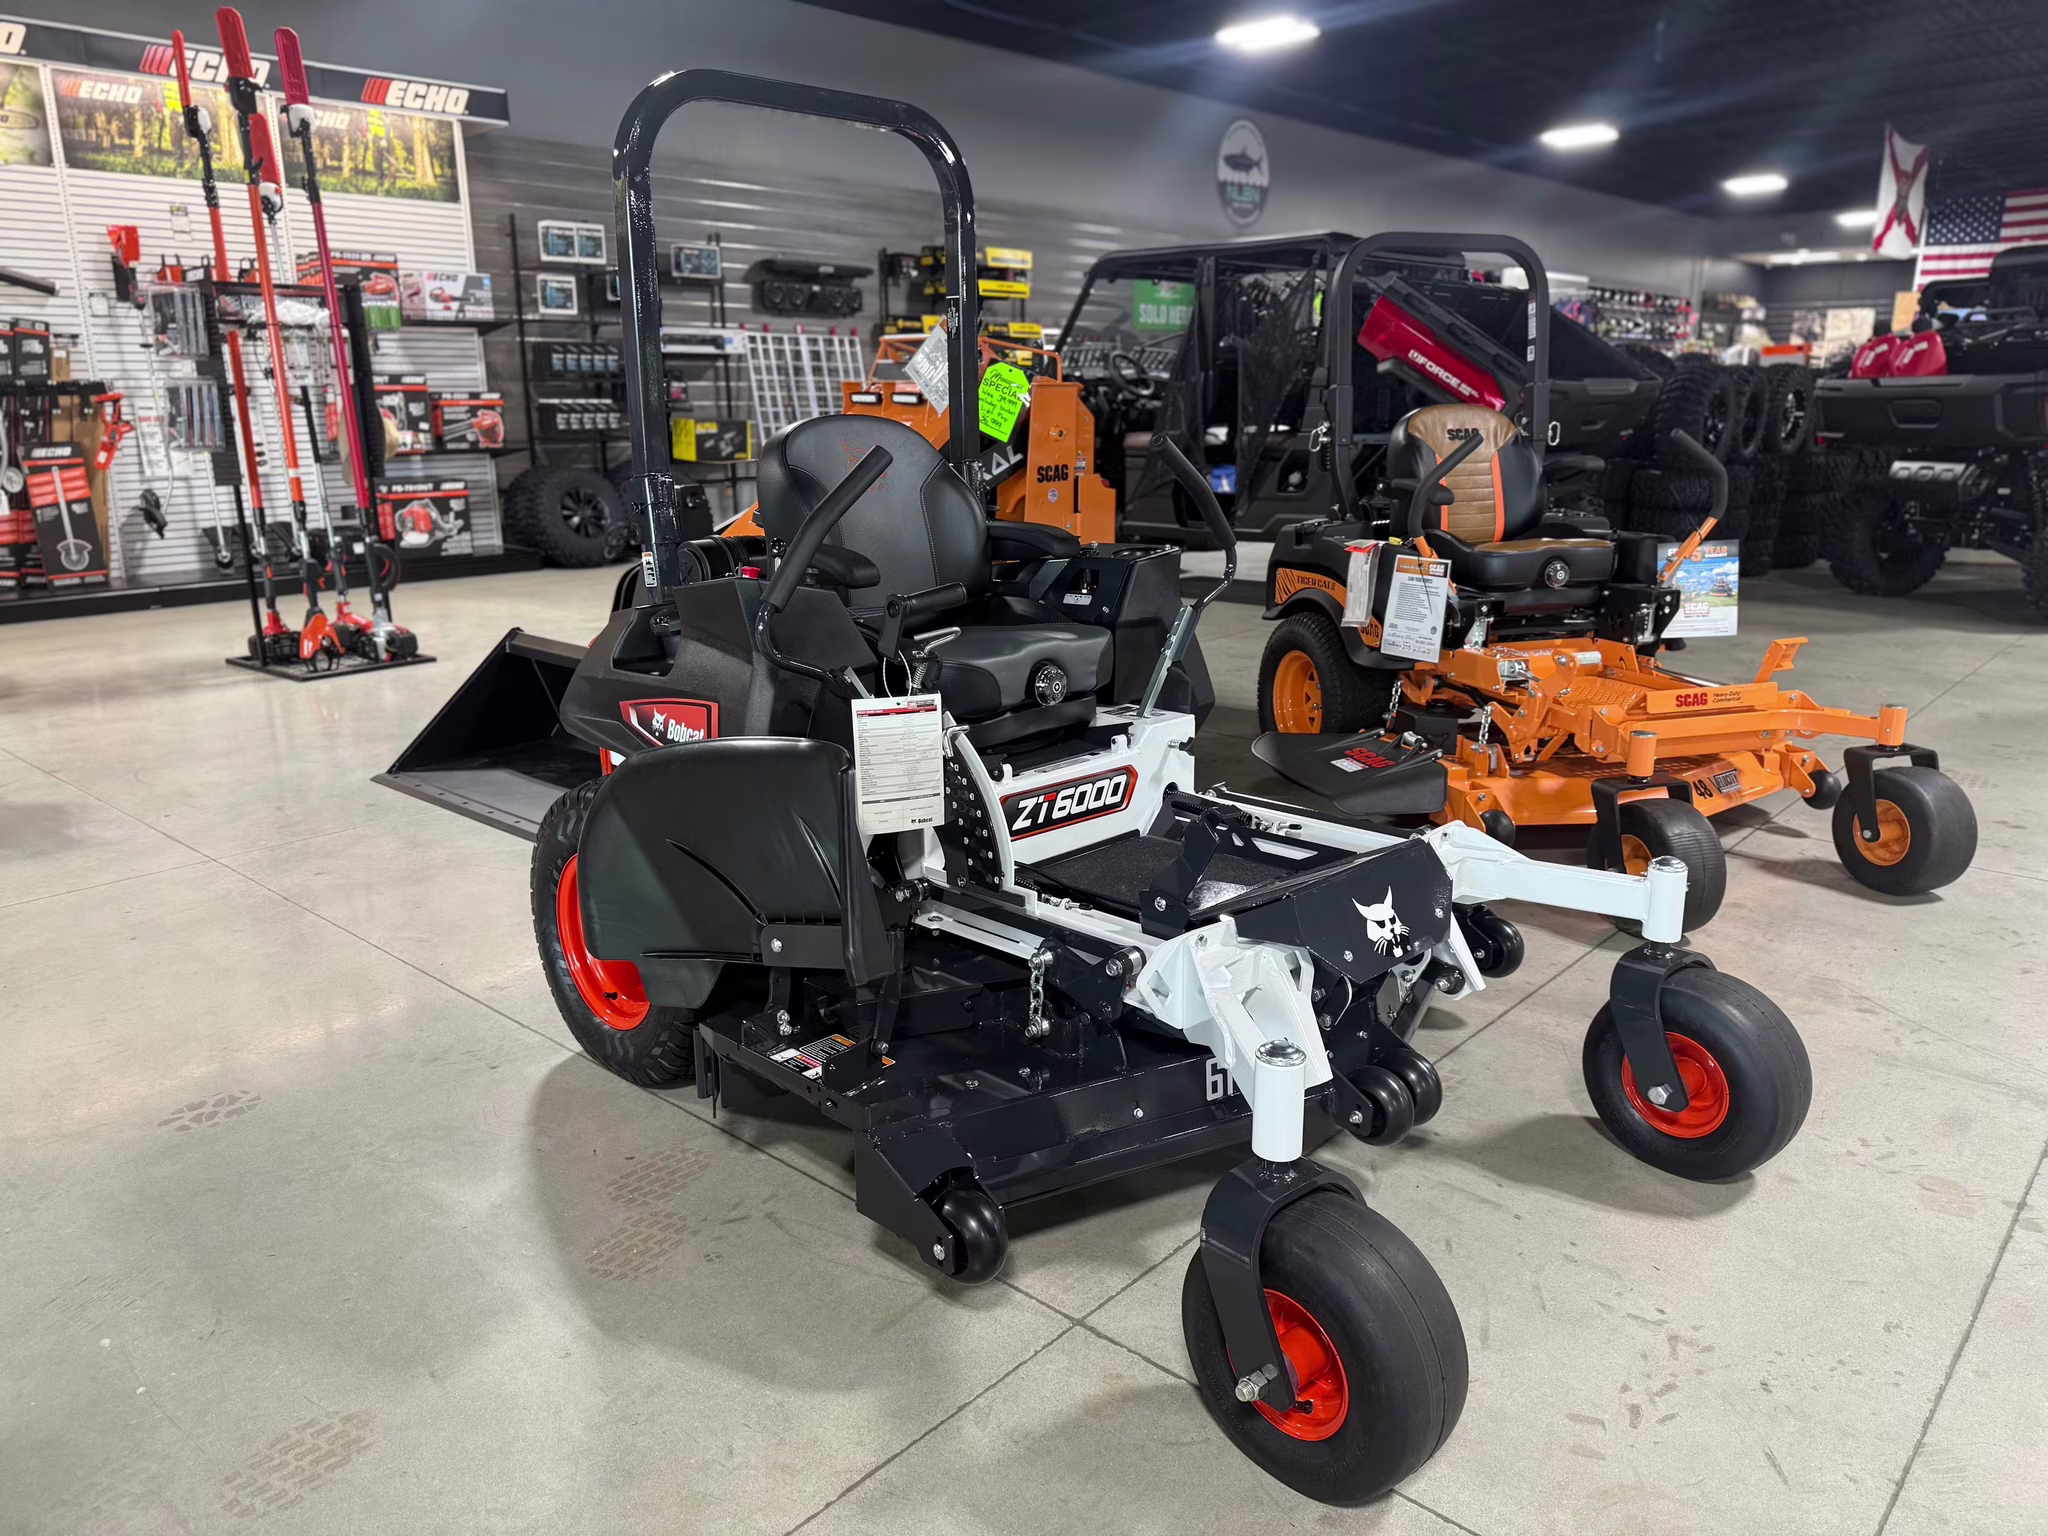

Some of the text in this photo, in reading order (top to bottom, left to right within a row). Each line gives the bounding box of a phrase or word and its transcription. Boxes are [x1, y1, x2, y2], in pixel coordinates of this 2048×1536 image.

[78, 79, 143, 104] ECHO
[385, 79, 470, 115] ECHO
[1037, 463, 1069, 484] SCAG
[1704, 545, 1728, 554] YEAR
[1296, 575, 1317, 587] TIGER
[1317, 579, 1332, 590] CAT
[1675, 692, 1708, 708] SCAG
[666, 718, 704, 743] Bobcat
[1692, 779, 1713, 799] 48
[1011, 774, 1128, 831] ZT6000
